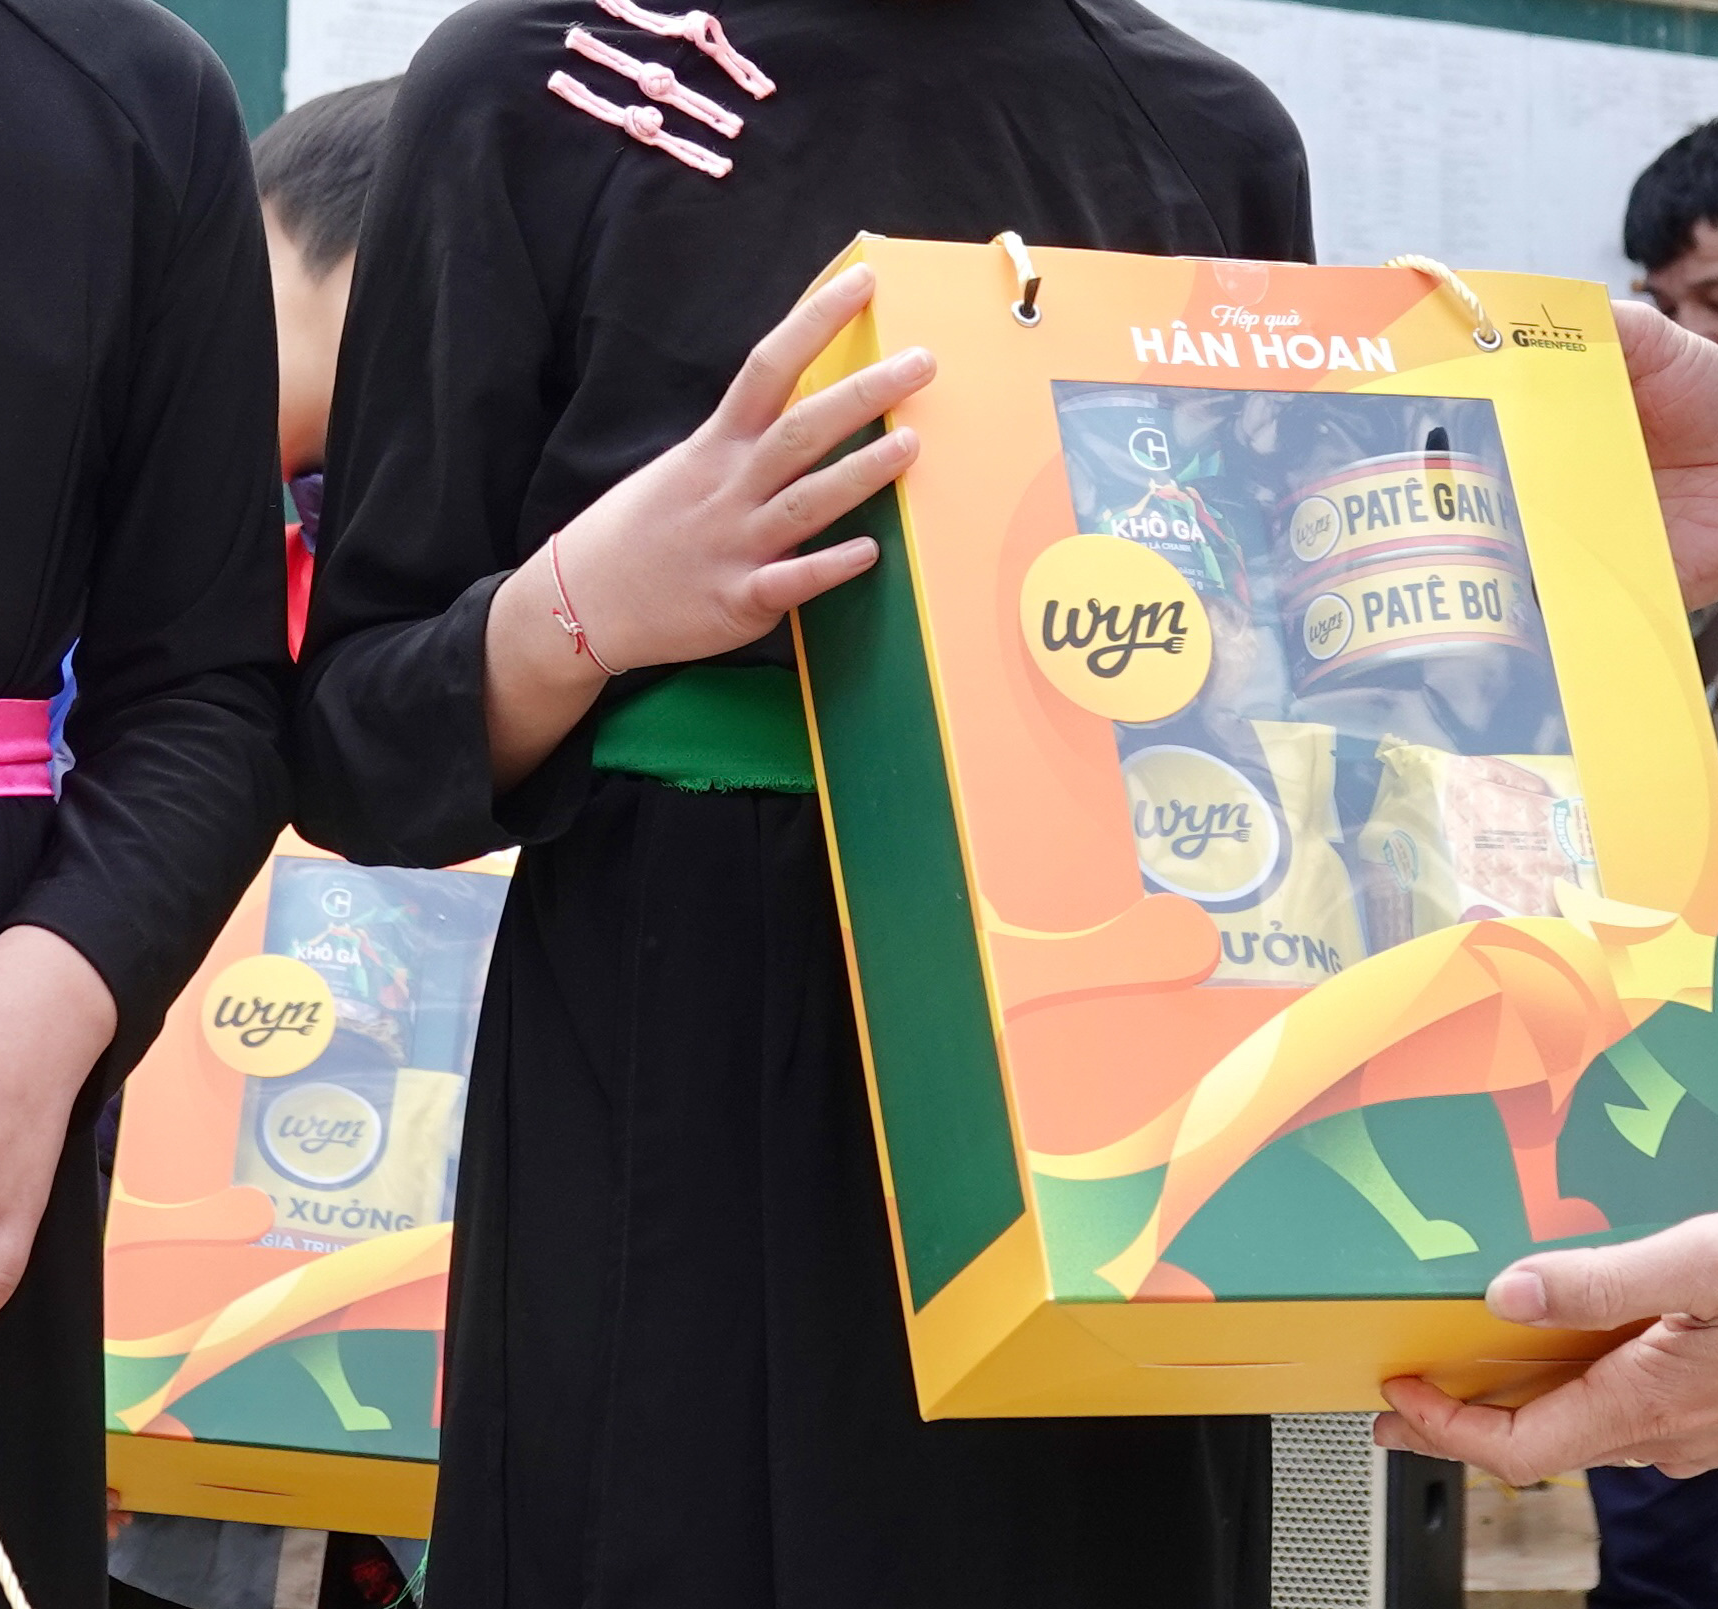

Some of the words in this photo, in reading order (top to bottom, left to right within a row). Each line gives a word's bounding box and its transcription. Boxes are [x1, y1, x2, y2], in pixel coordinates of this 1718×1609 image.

[1210, 304, 1259, 332] Hộp
[1265, 309, 1302, 332] quà
[1129, 319, 1240, 368] HÂN
[1249, 333, 1397, 373] HOAN
[1111, 510, 1168, 539] KHÔ
[1343, 477, 1429, 535] PATÊ
[1433, 483, 1496, 530] GAN
[1362, 574, 1451, 633] PATÊ
[1043, 598, 1188, 678] wyn
[1134, 799, 1252, 860] wyn
[295, 941, 333, 962] KHÔ
[1220, 920, 1344, 974] ƯỞNG
[214, 996, 323, 1048] wyn
[278, 1114, 367, 1154] wyn
